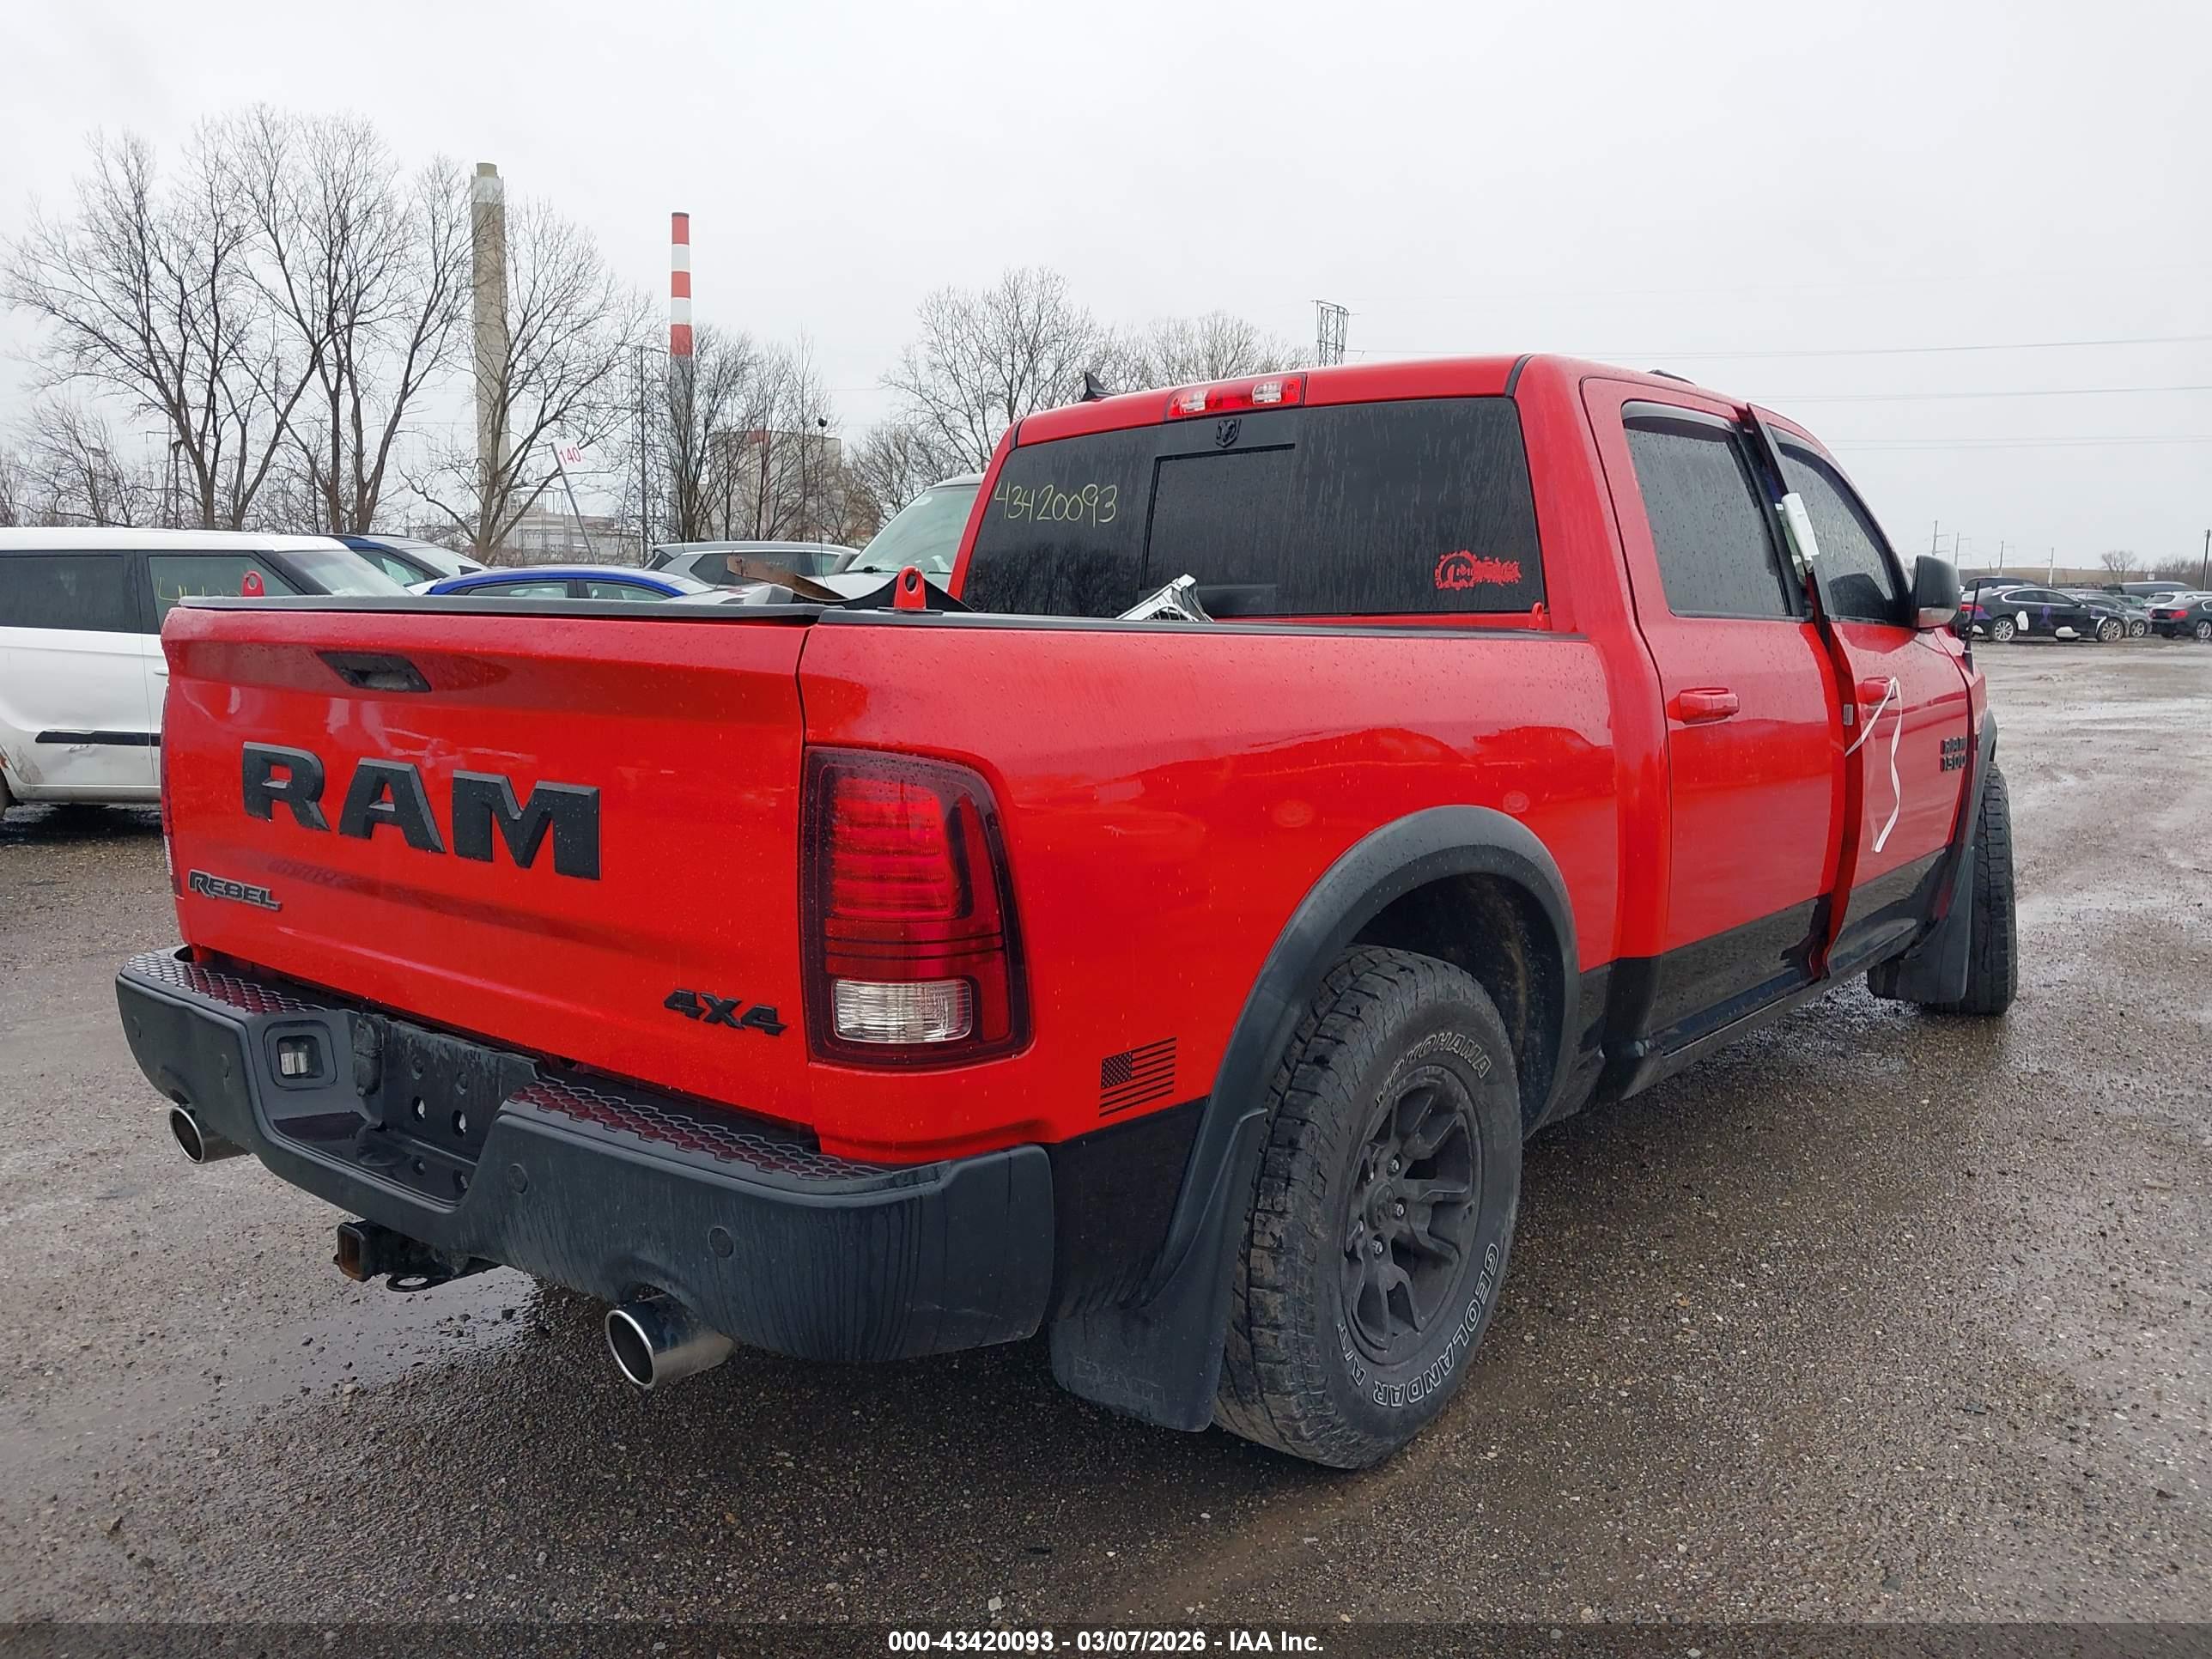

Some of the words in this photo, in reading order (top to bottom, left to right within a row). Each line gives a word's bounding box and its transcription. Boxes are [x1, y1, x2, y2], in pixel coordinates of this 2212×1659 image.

[559, 447, 581, 465] 140
[994, 481, 1118, 528] 43420093
[242, 741, 601, 881] RAM
[189, 868, 282, 912] REBEL
[1373, 1243, 1499, 1407] GEOLANDAR
